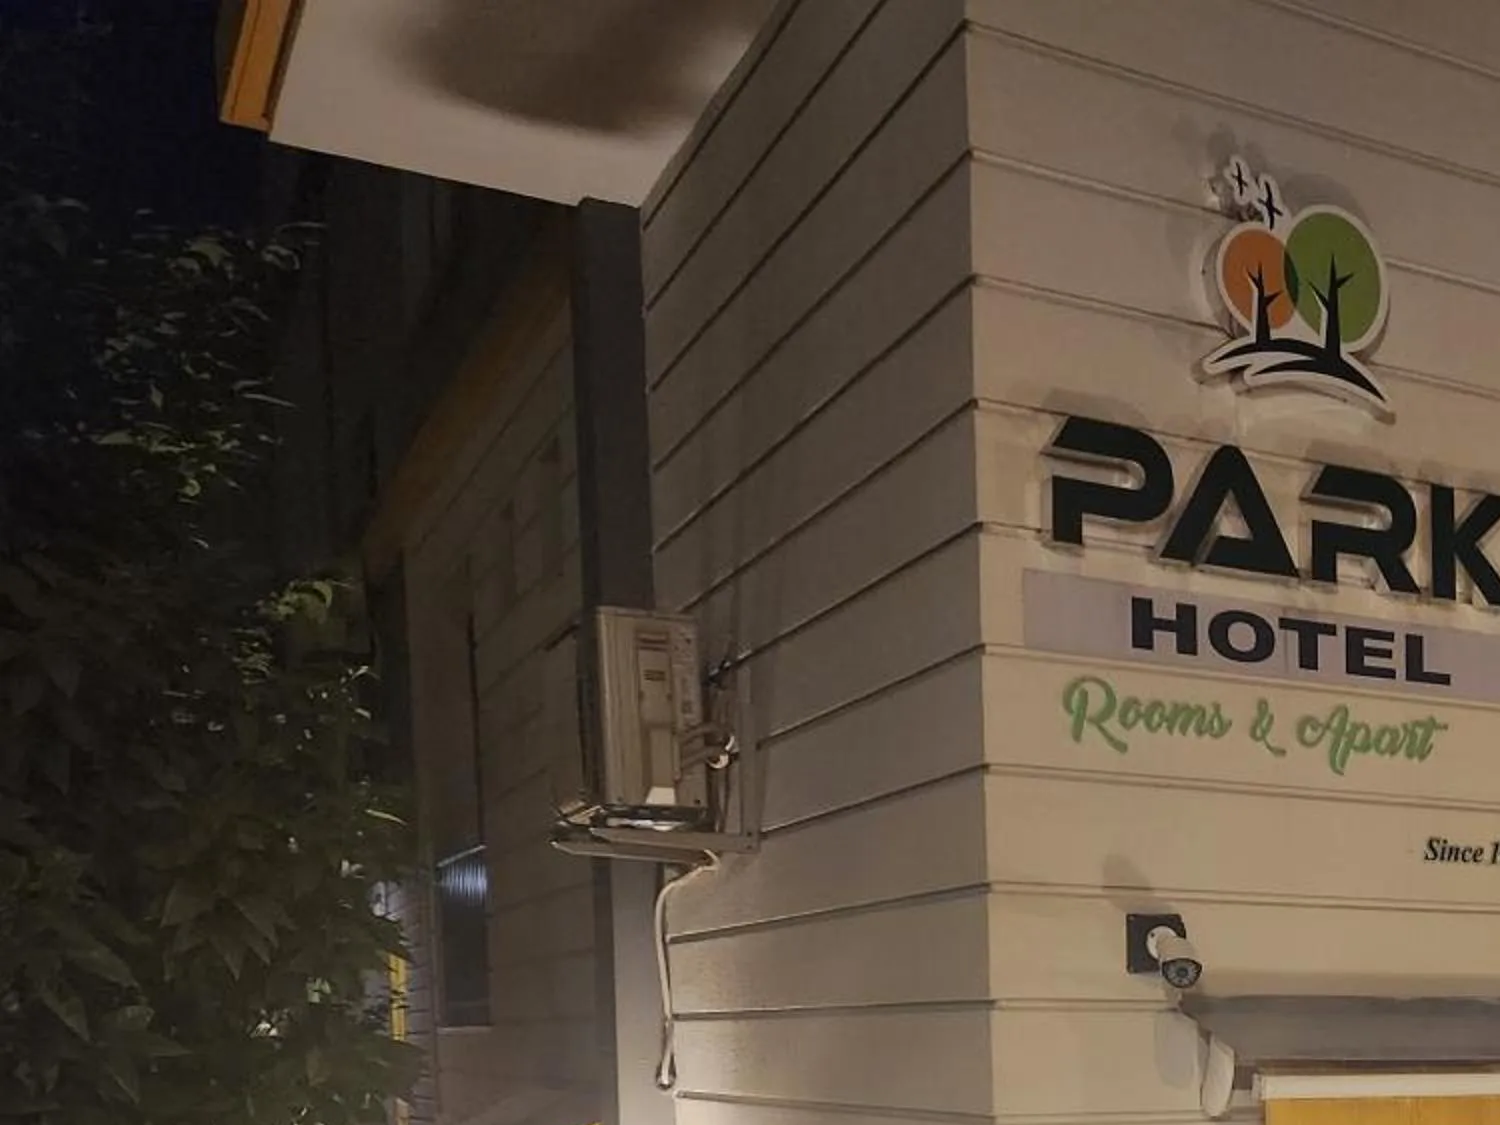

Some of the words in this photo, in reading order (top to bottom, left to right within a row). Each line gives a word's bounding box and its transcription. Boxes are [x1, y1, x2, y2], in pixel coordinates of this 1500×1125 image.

[1130, 596, 1451, 686] HOTEL
[1062, 674, 1232, 755] Rooms
[1249, 699, 1287, 757] &
[1295, 704, 1449, 776] Apart
[1423, 836, 1485, 865] Since
